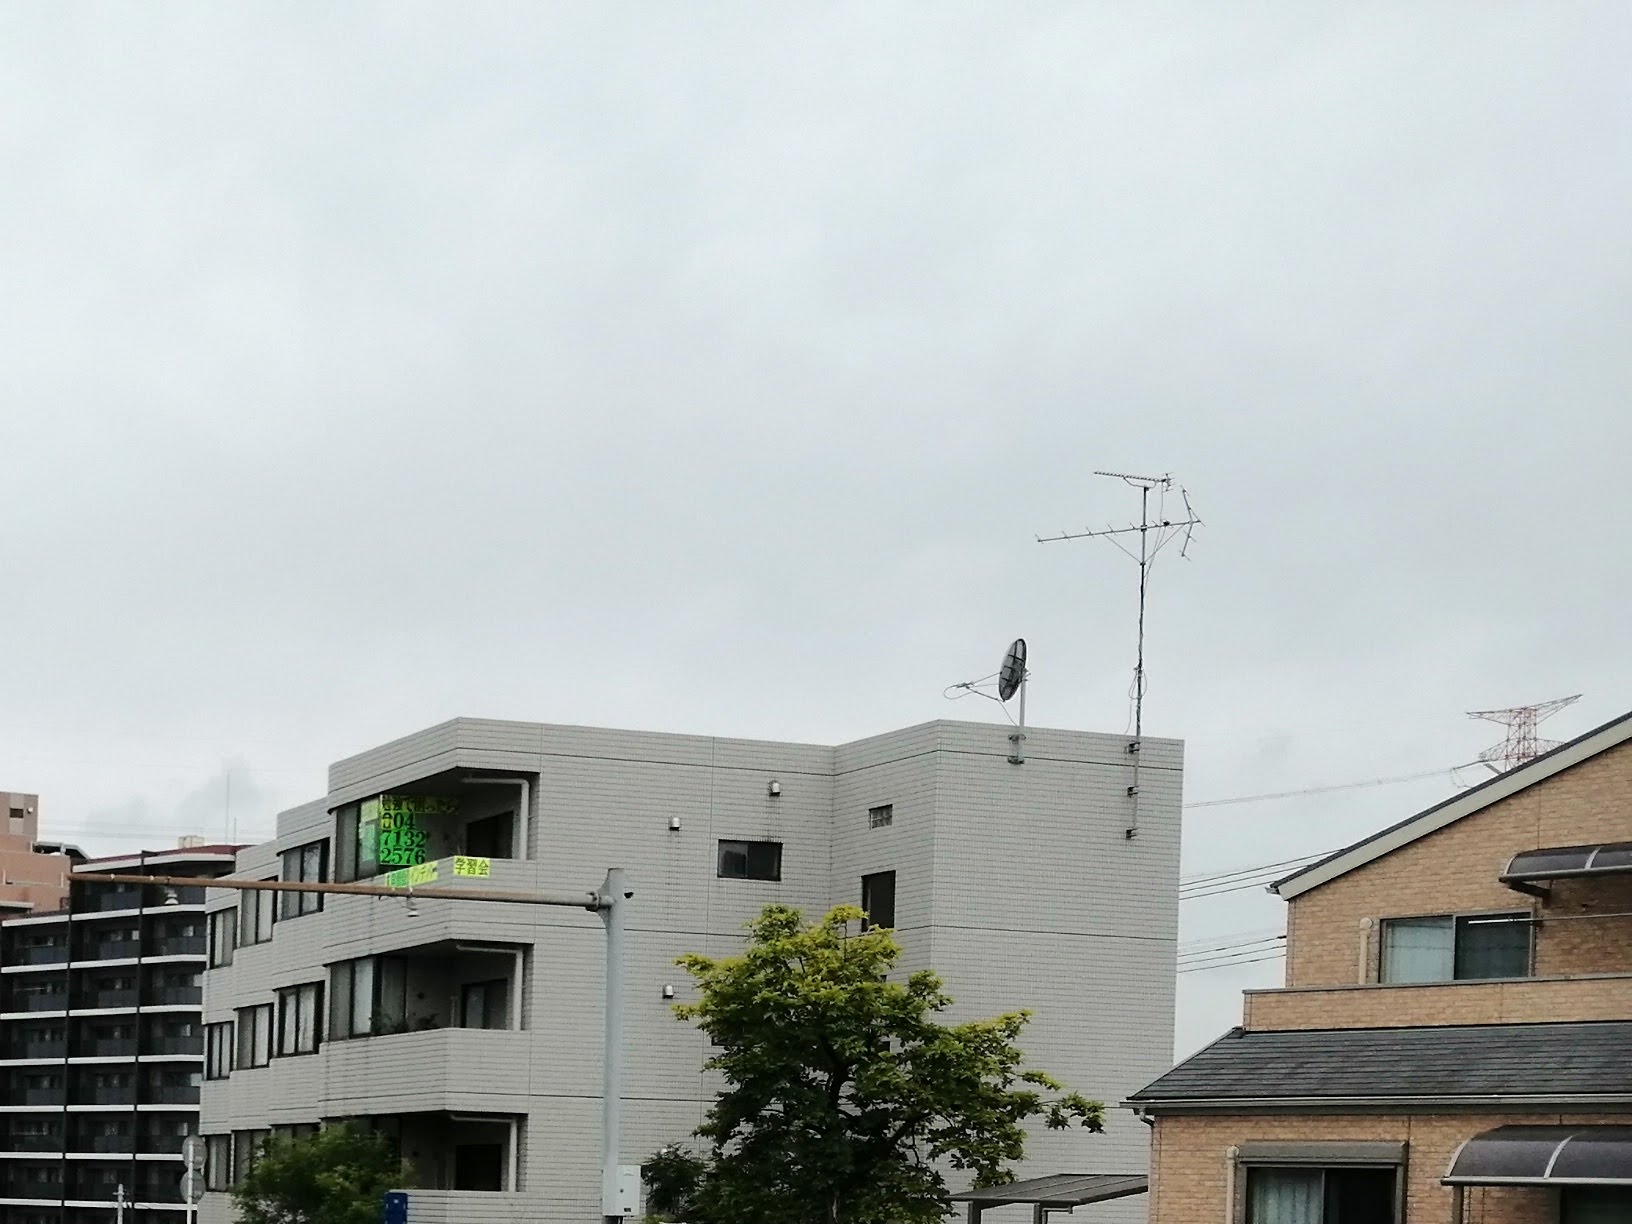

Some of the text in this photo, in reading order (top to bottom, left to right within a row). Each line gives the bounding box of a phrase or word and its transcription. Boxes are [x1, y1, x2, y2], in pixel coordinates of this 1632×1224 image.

[381, 830, 426, 847] 7132
[381, 847, 426, 865] 2576
[455, 857, 489, 876] 学習会
